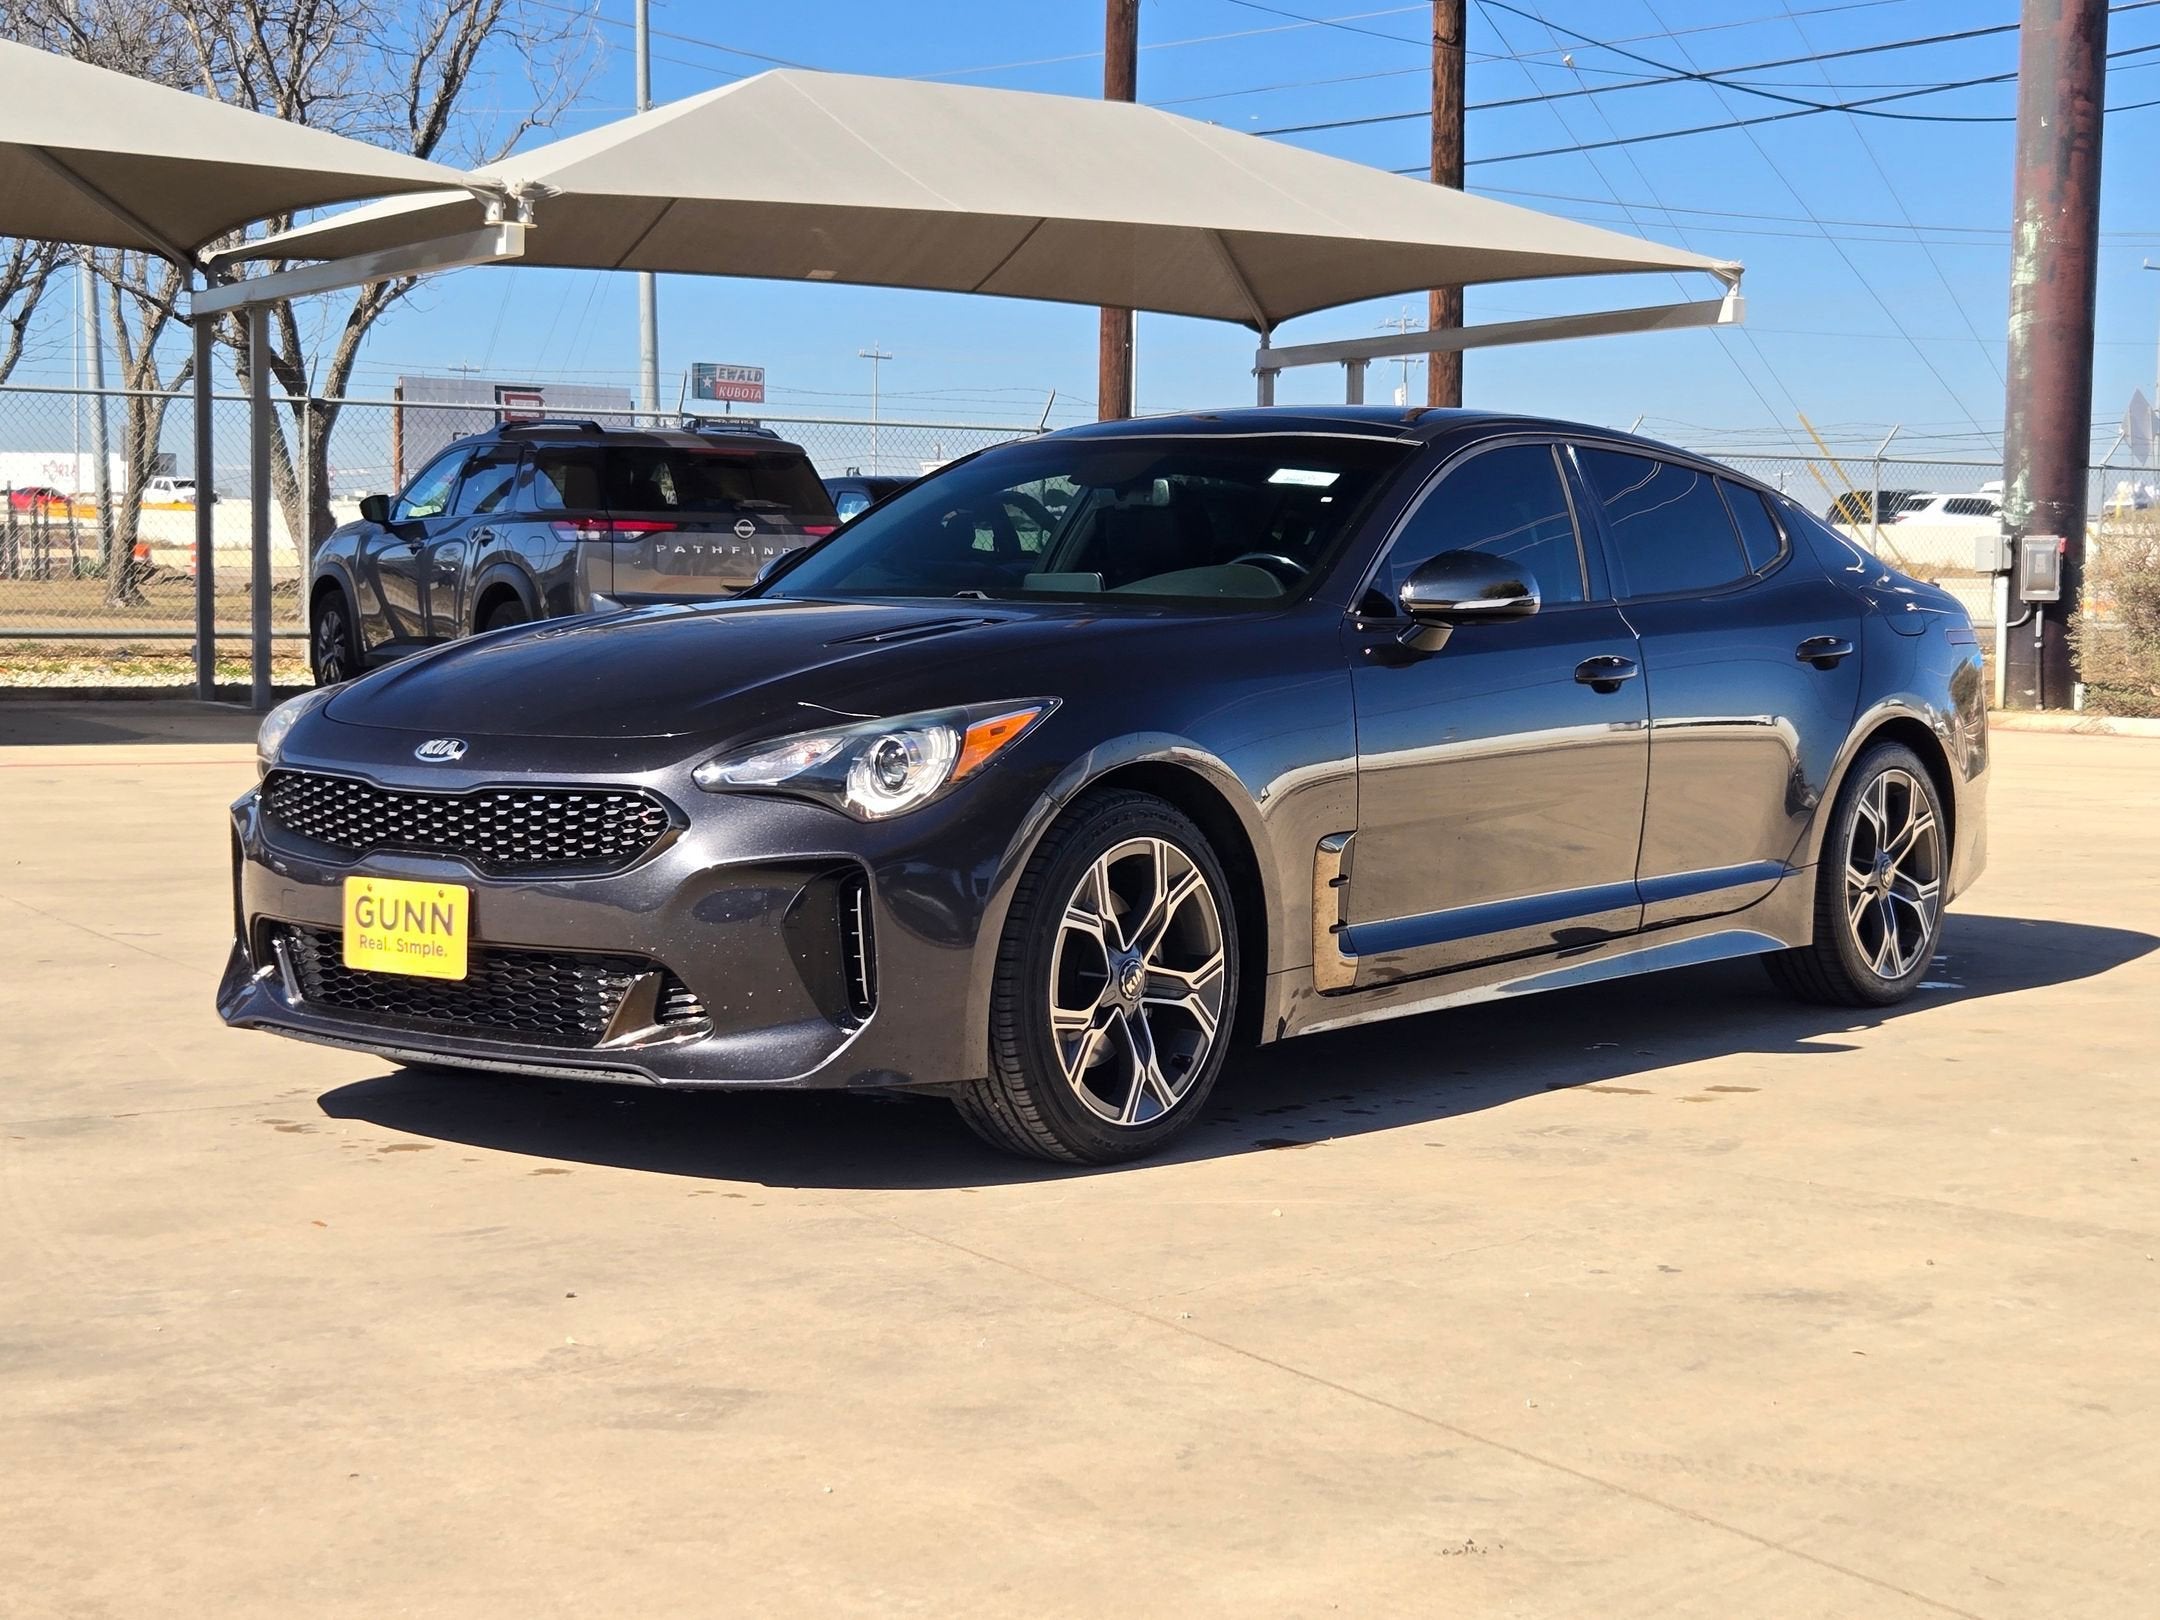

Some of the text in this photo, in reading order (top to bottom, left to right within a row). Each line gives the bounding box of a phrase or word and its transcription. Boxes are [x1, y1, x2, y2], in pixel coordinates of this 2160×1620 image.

[718, 367, 763, 382] EWALD
[718, 385, 762, 399] KUBOTA
[419, 740, 460, 755] KIA
[355, 895, 454, 937] GUNN
[359, 934, 448, 958] Real. Simple.
[1126, 968, 1143, 994] KIA
